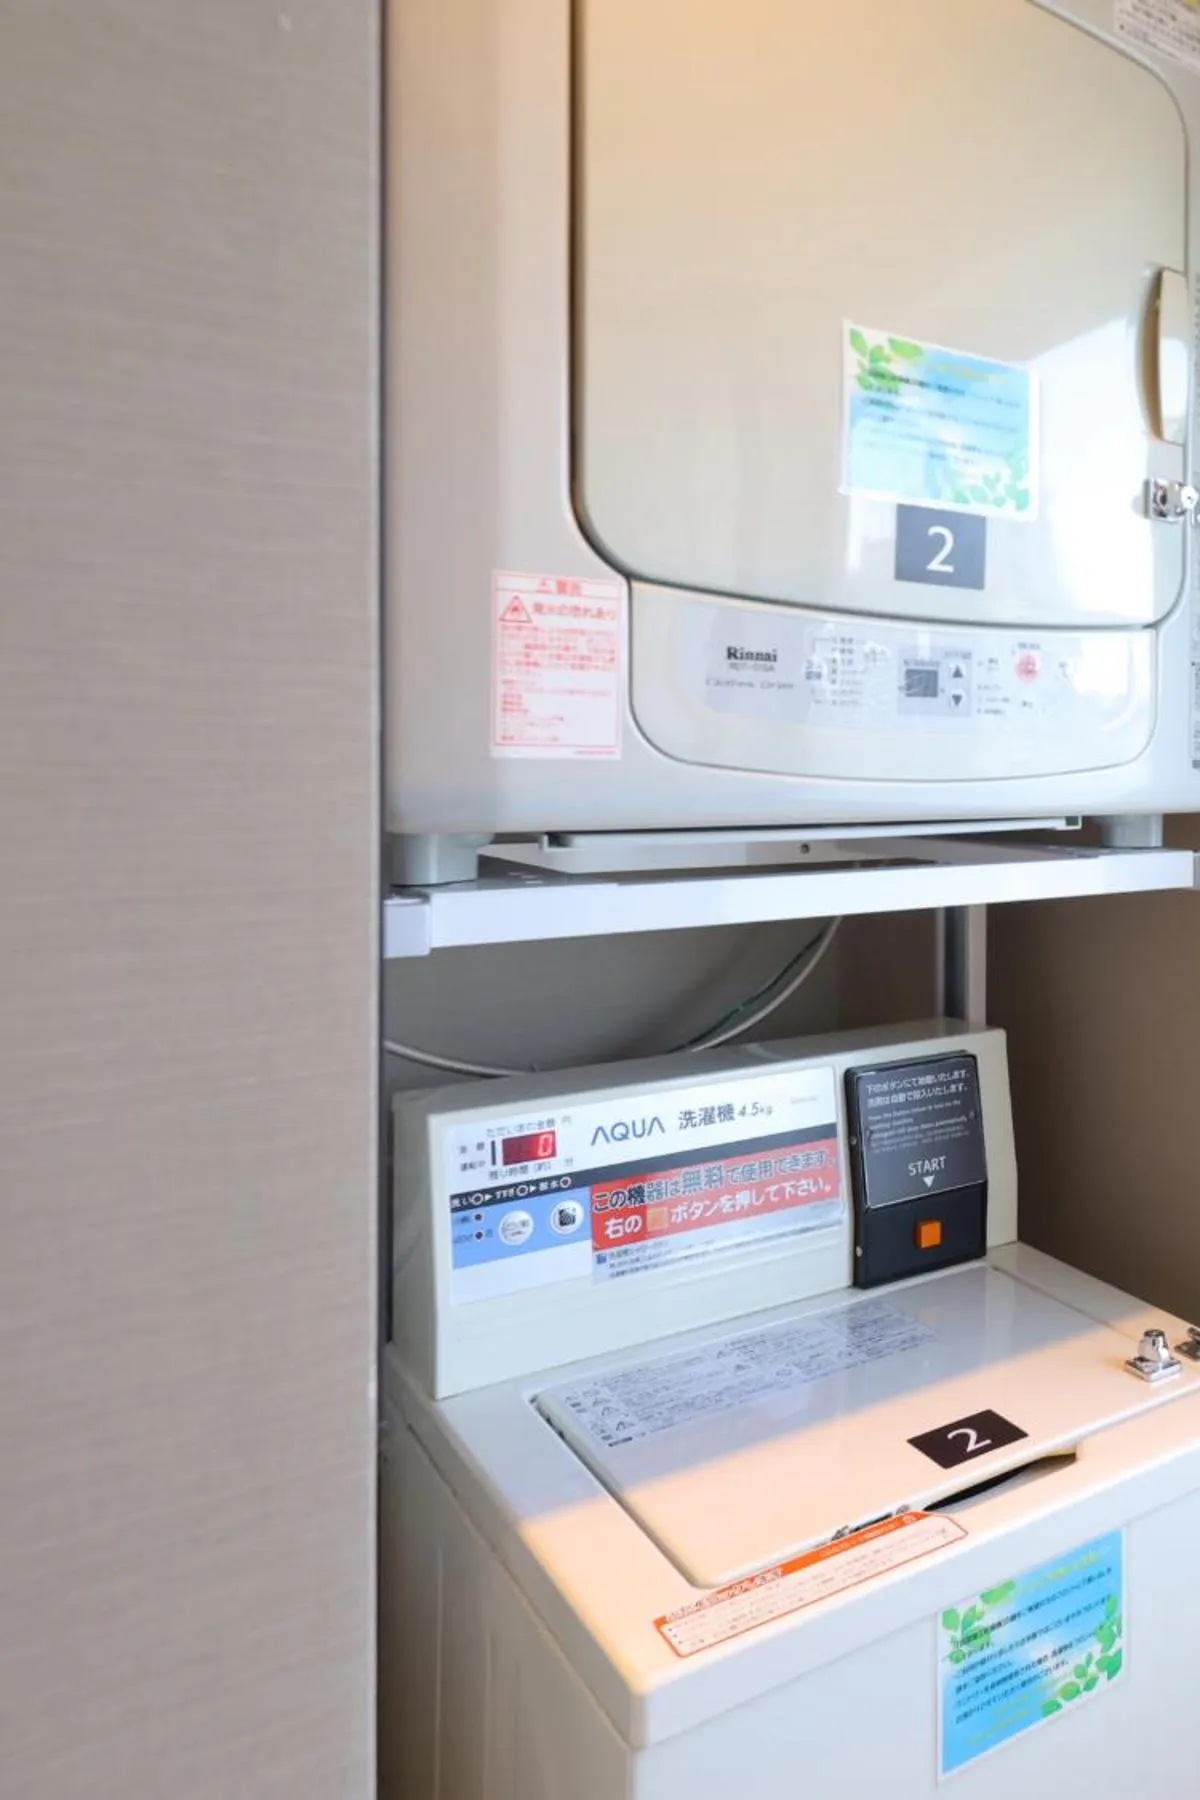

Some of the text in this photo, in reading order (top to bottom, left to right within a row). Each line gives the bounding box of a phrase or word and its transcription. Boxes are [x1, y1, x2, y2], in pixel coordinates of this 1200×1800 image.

[926, 525, 955, 573] 2
[727, 646, 777, 662] Rinnai
[678, 1103, 736, 1130] 洗濯機
[591, 1116, 666, 1146] AQUA
[538, 1133, 552, 1157] 0
[908, 1156, 946, 1176] START
[605, 1215, 642, 1239] 右の
[947, 1428, 992, 1453] 2
